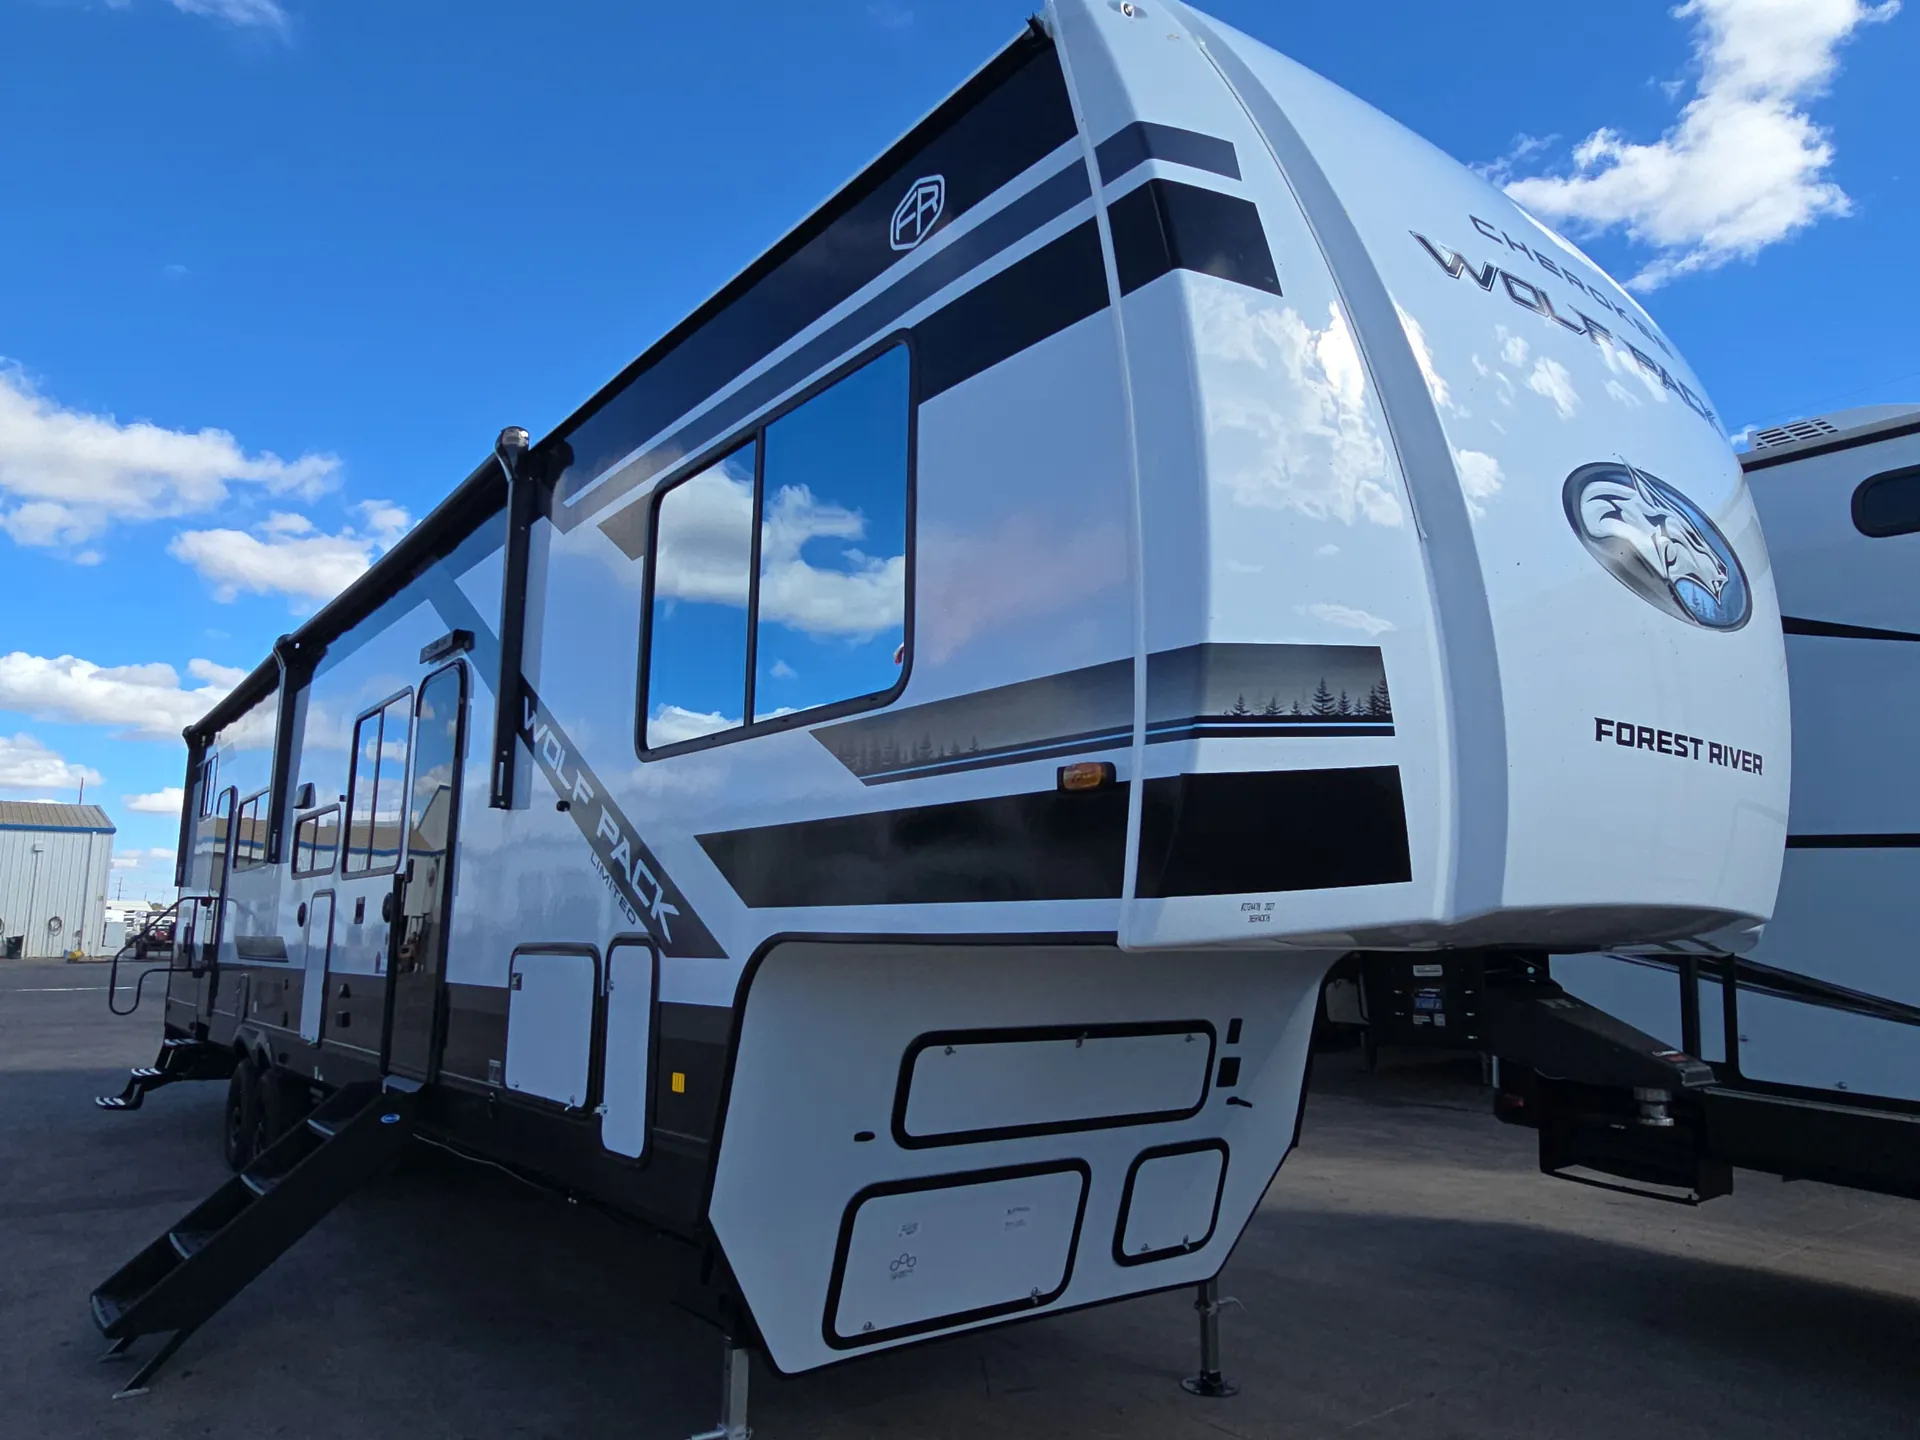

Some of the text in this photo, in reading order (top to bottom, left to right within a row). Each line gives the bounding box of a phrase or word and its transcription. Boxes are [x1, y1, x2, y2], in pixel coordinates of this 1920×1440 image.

[1408, 230, 1727, 442] WOLF PACK
[1594, 717, 1763, 776] FOREST RIVER
[524, 696, 680, 943] WOLF PACK
[590, 851, 636, 925] LIMITED
